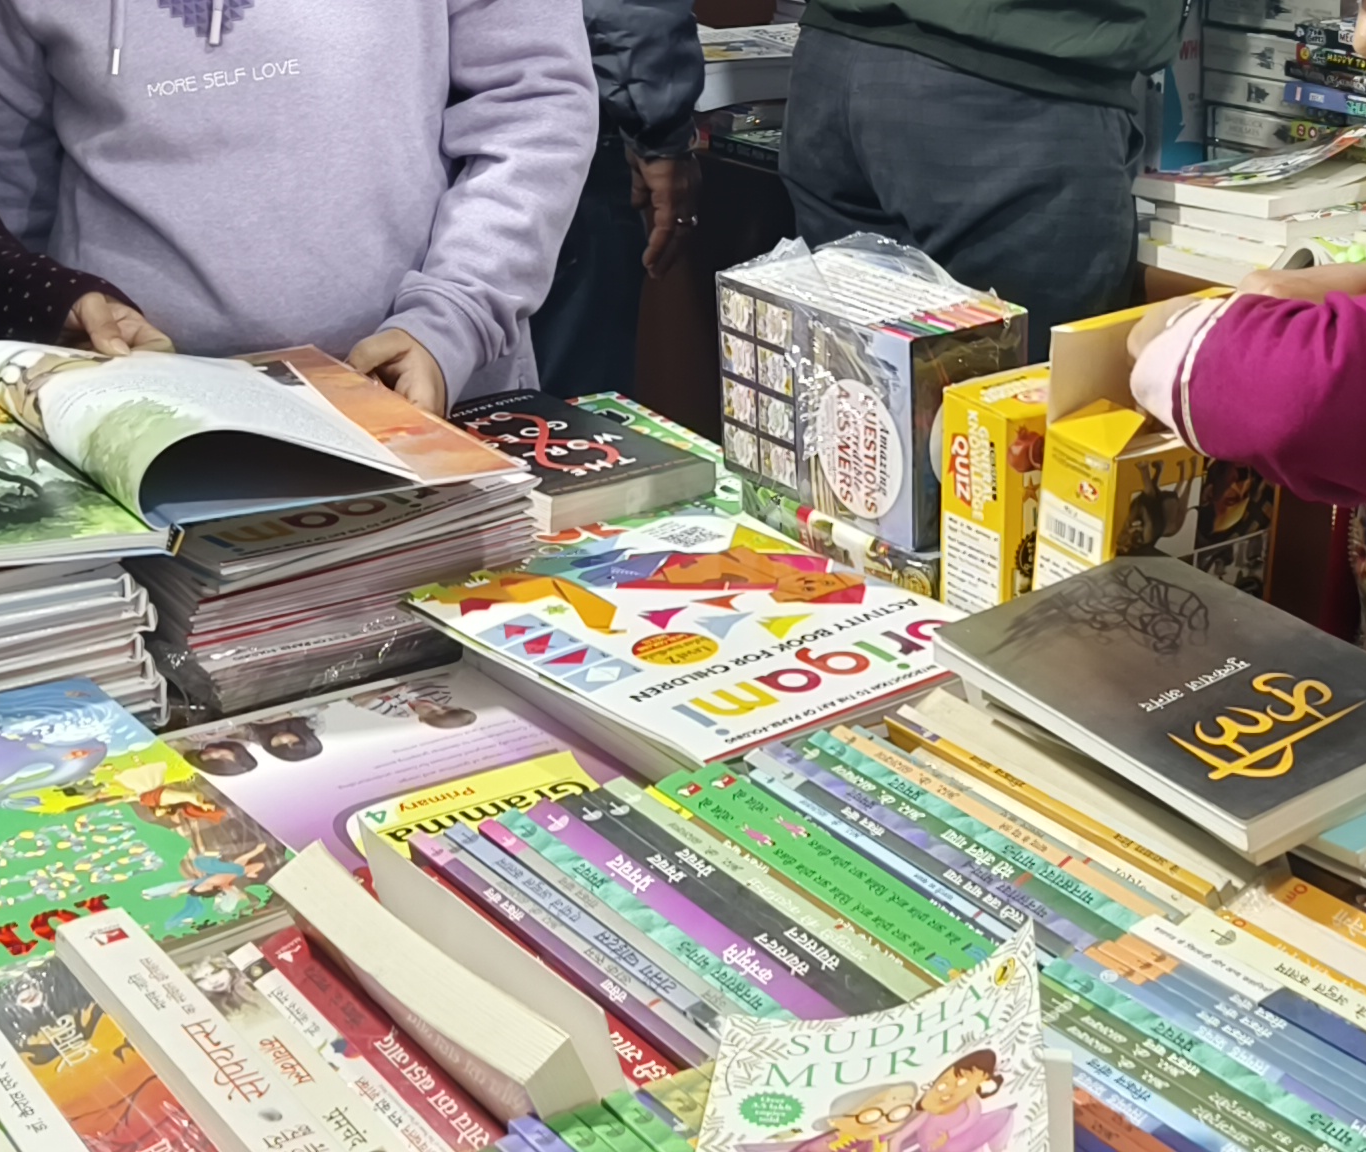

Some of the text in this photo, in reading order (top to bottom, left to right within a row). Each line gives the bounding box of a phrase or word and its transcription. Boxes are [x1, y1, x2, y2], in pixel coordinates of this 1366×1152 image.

[147, 59, 300, 97] MORE SELF LOVE
[952, 435, 972, 501] QUIZ
[629, 598, 918, 704] ACTIVITY BOOK FOR CHILDREN
[802, 698, 836, 718] ART OF
[1137, 657, 1253, 714] मुल्कराज आनंद
[365, 809, 387, 824] 4
[398, 786, 475, 813] Primary
[607, 852, 774, 985] प्रेमचंद कर्मभूमि
[646, 851, 812, 978] प्रेमचंद सेवासदन
[675, 847, 841, 972] प्रेमचंद सेवासदन
[762, 998, 999, 1088] MURTY
[787, 984, 985, 1057] SUDHA
[181, 1017, 270, 1103] सेपियन्स
[259, 1035, 316, 1087] कायाकल्प
[427, 1087, 459, 1117] का
